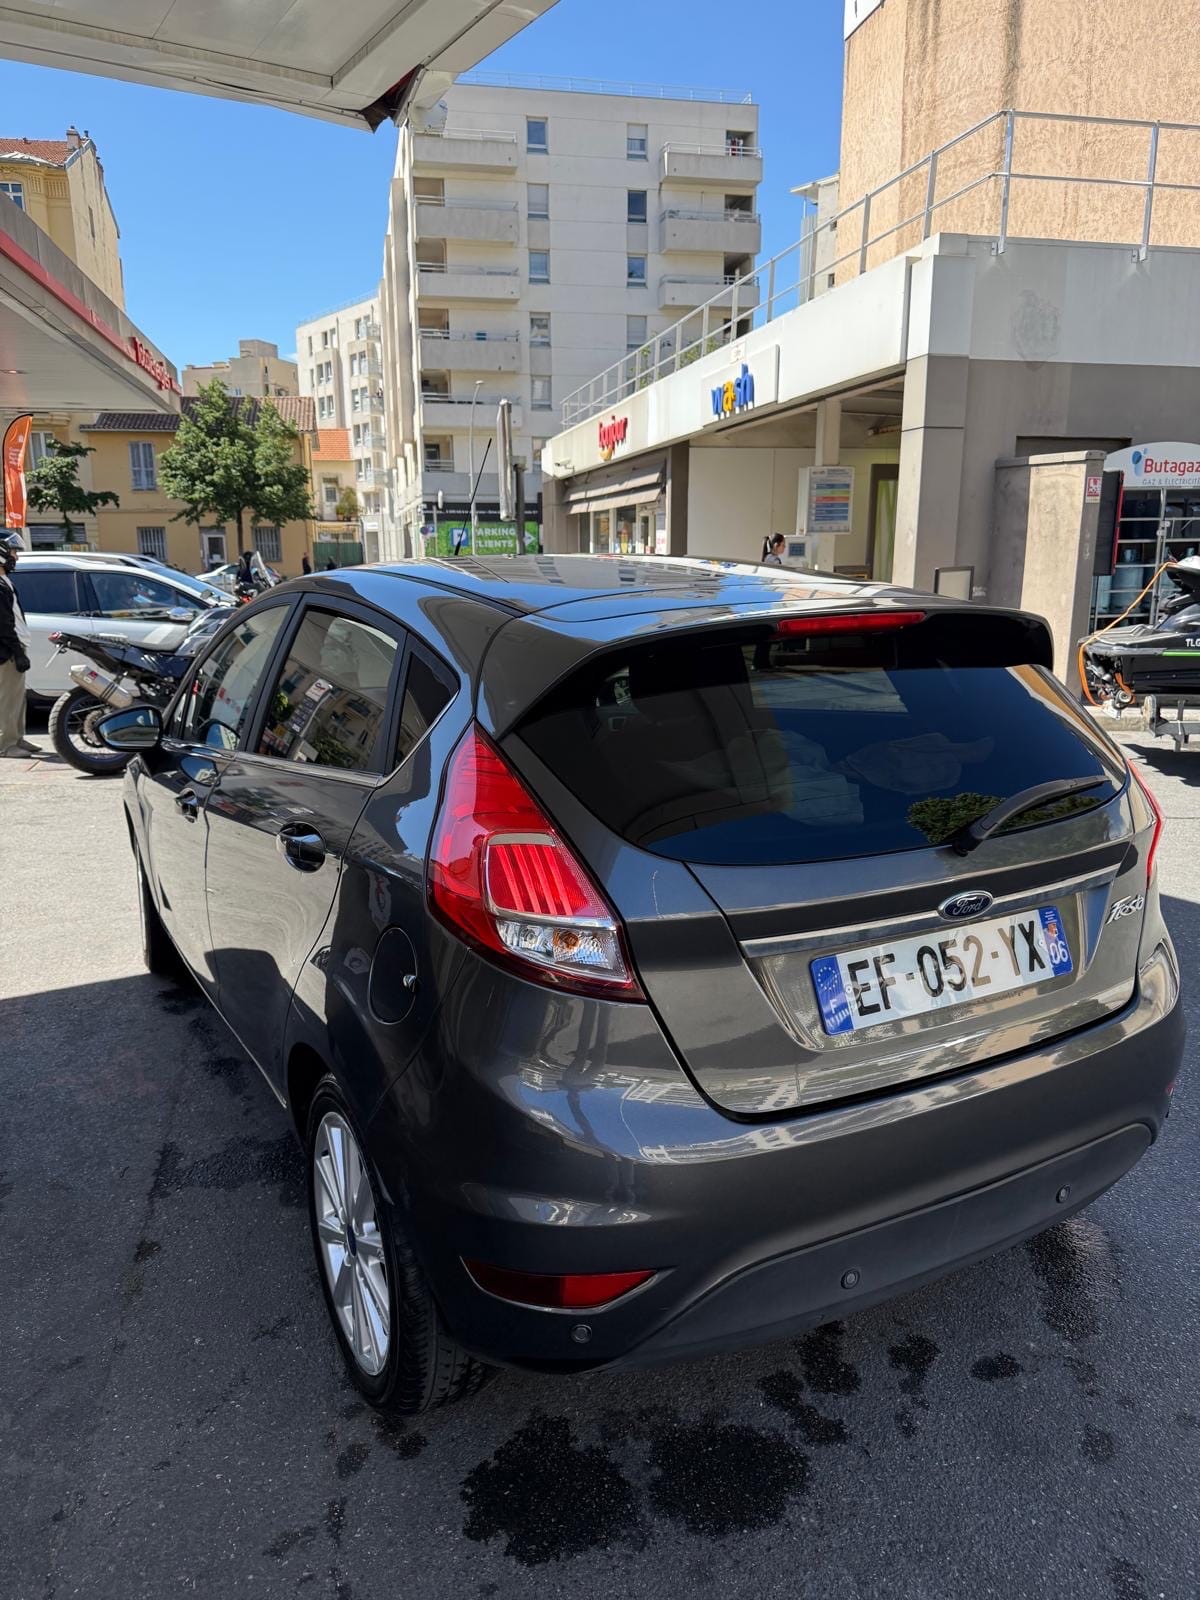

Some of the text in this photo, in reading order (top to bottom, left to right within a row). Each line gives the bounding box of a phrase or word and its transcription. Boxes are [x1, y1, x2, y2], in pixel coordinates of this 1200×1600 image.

[711, 363, 755, 415] wash
[1144, 458, 1200, 476] Butagaz
[475, 527, 516, 536] ARKING
[952, 896, 984, 916] Ford
[1105, 894, 1145, 925] Fiesta
[1050, 940, 1069, 965] 06
[847, 920, 1046, 1017] EF-052-YX
[830, 999, 838, 1014] F
